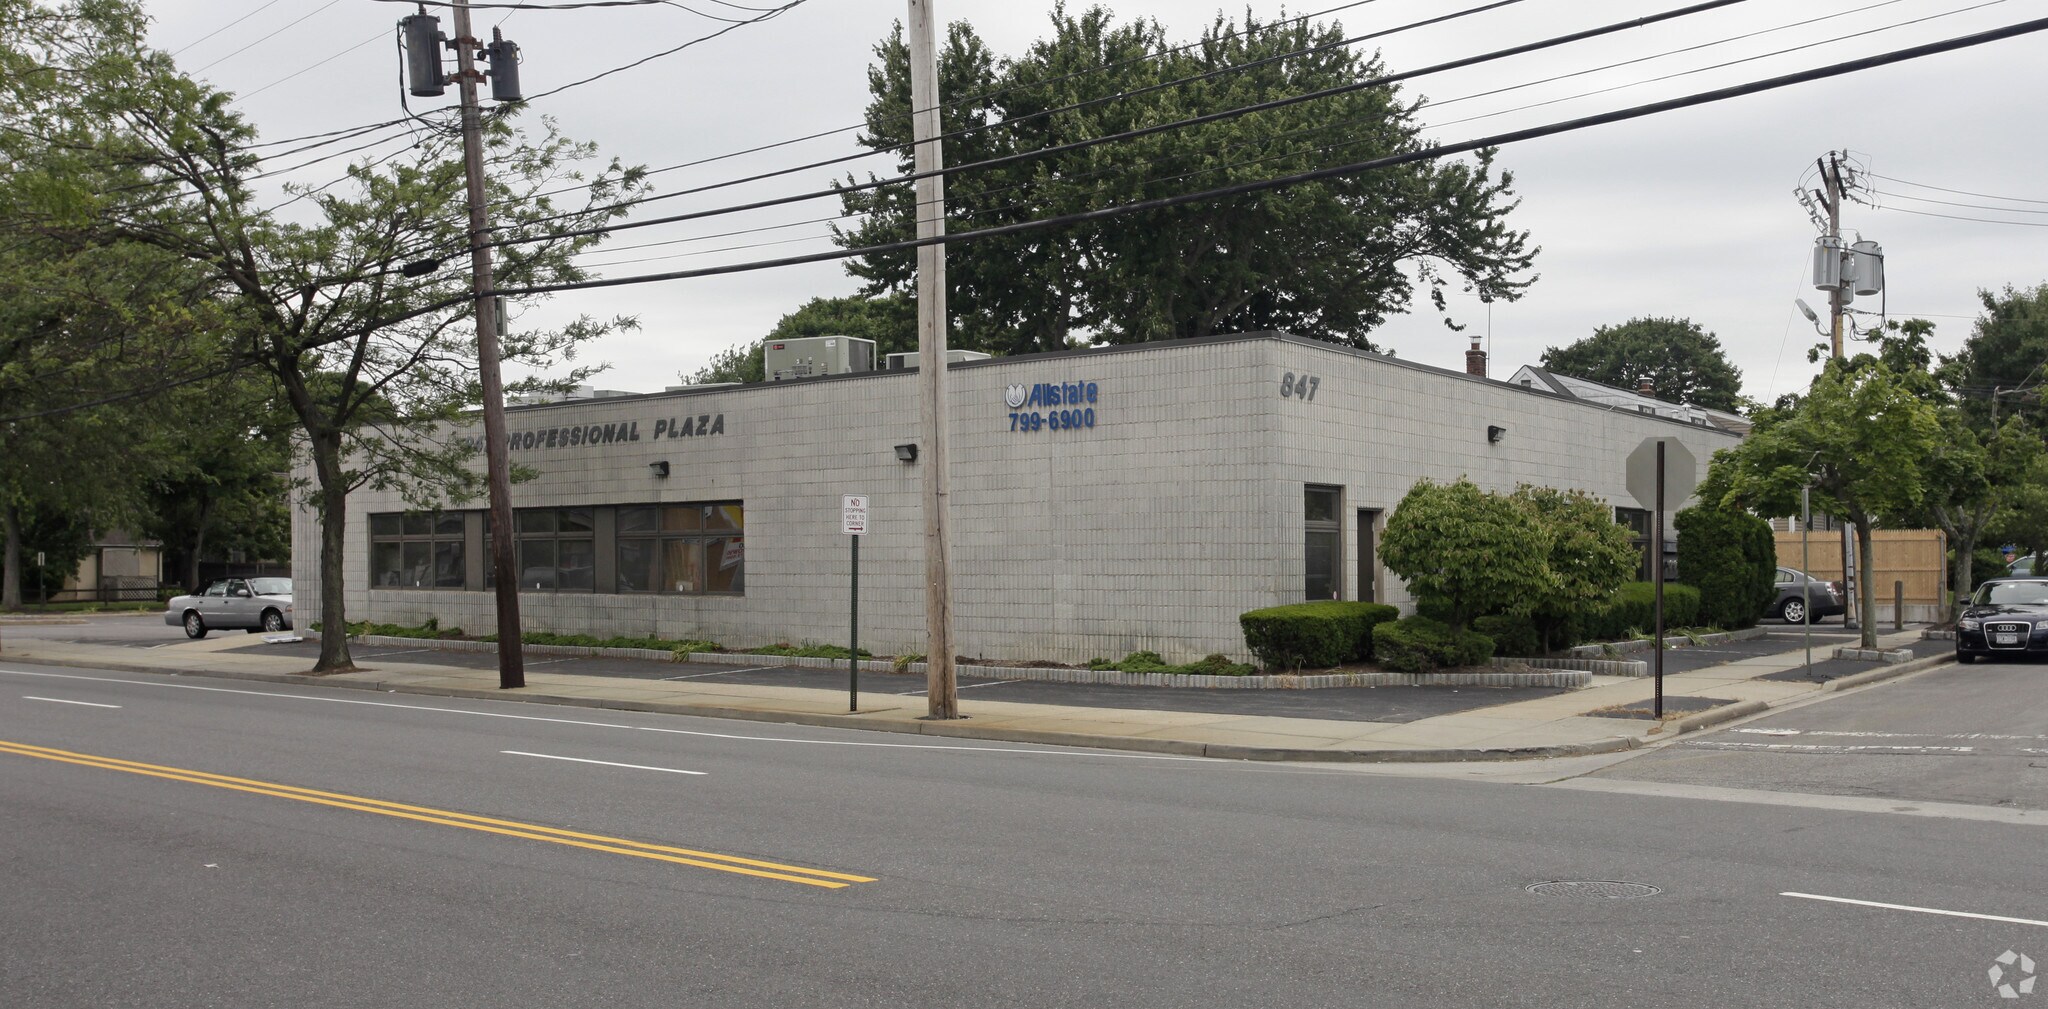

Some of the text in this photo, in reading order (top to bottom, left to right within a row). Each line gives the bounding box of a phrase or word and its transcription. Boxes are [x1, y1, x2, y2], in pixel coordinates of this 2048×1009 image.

[1027, 380, 1098, 407] Allstate
[1280, 371, 1321, 401] 847
[653, 413, 725, 440] PLAZA
[1008, 407, 1095, 432] 799-6900
[850, 498, 860, 507] NO
